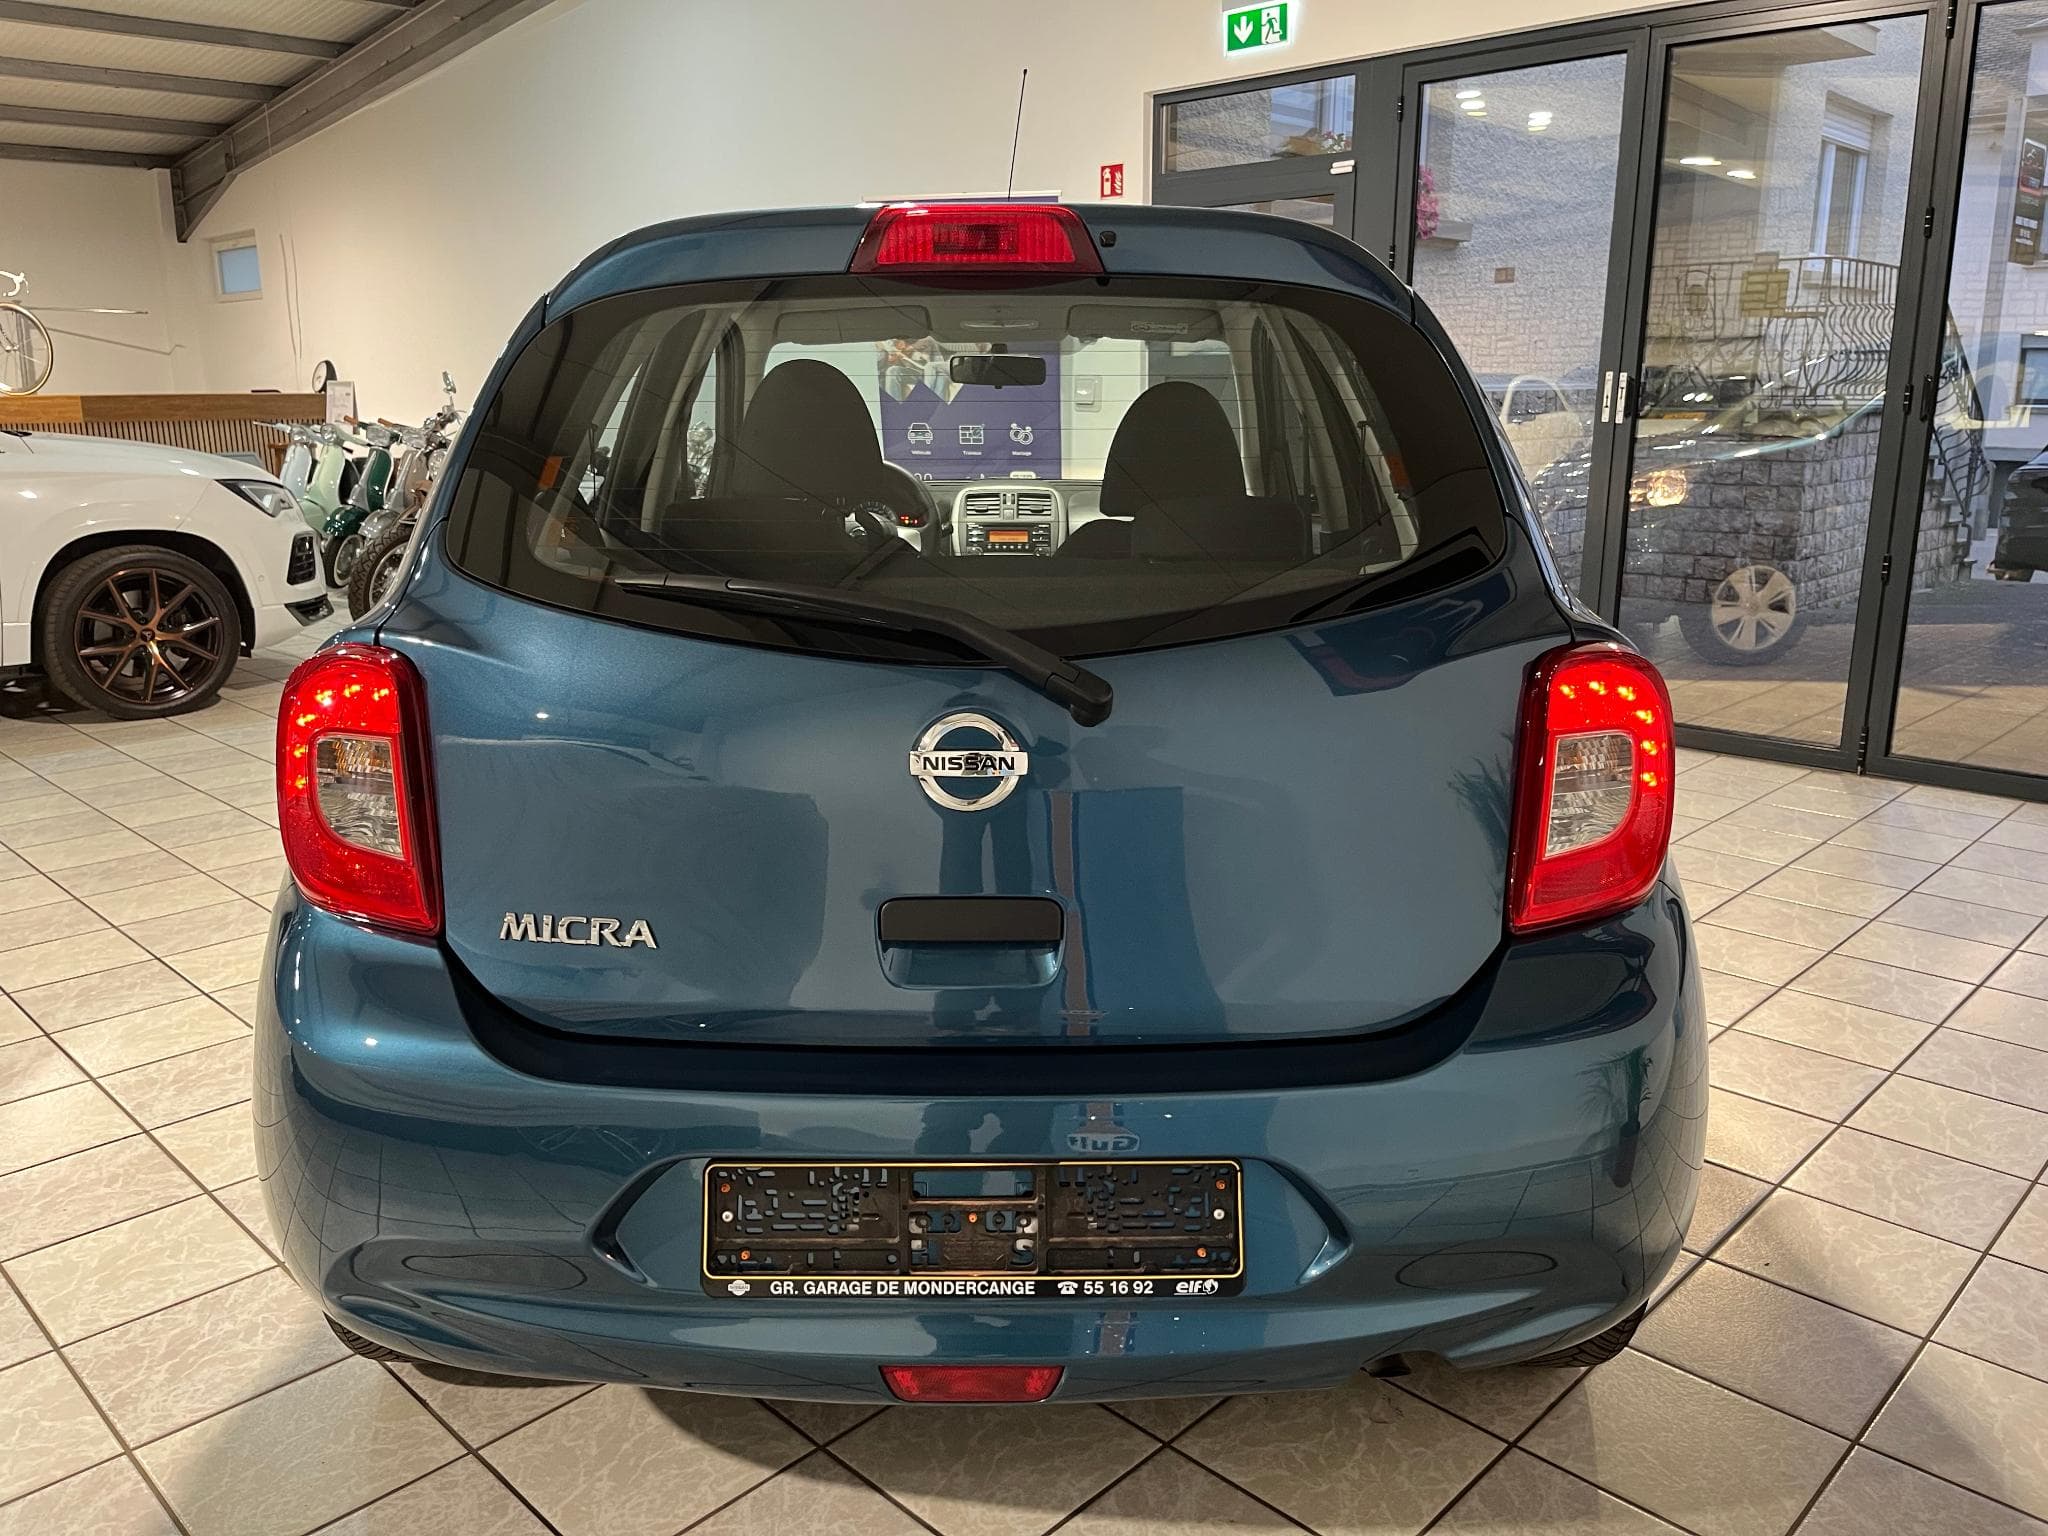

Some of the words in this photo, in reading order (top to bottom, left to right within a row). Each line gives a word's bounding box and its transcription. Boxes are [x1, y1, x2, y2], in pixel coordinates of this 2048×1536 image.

[922, 756, 1016, 771] NISSAN
[500, 912, 658, 949] MICRA
[769, 1280, 799, 1295] GR.
[803, 1280, 873, 1295] GARAGE
[876, 1280, 900, 1295] DE
[903, 1280, 1036, 1295] MONDERCANGE
[1083, 1280, 1105, 1295] 55
[1109, 1280, 1129, 1295] 16
[1132, 1280, 1154, 1295] 92
[1174, 1280, 1203, 1295] elf
